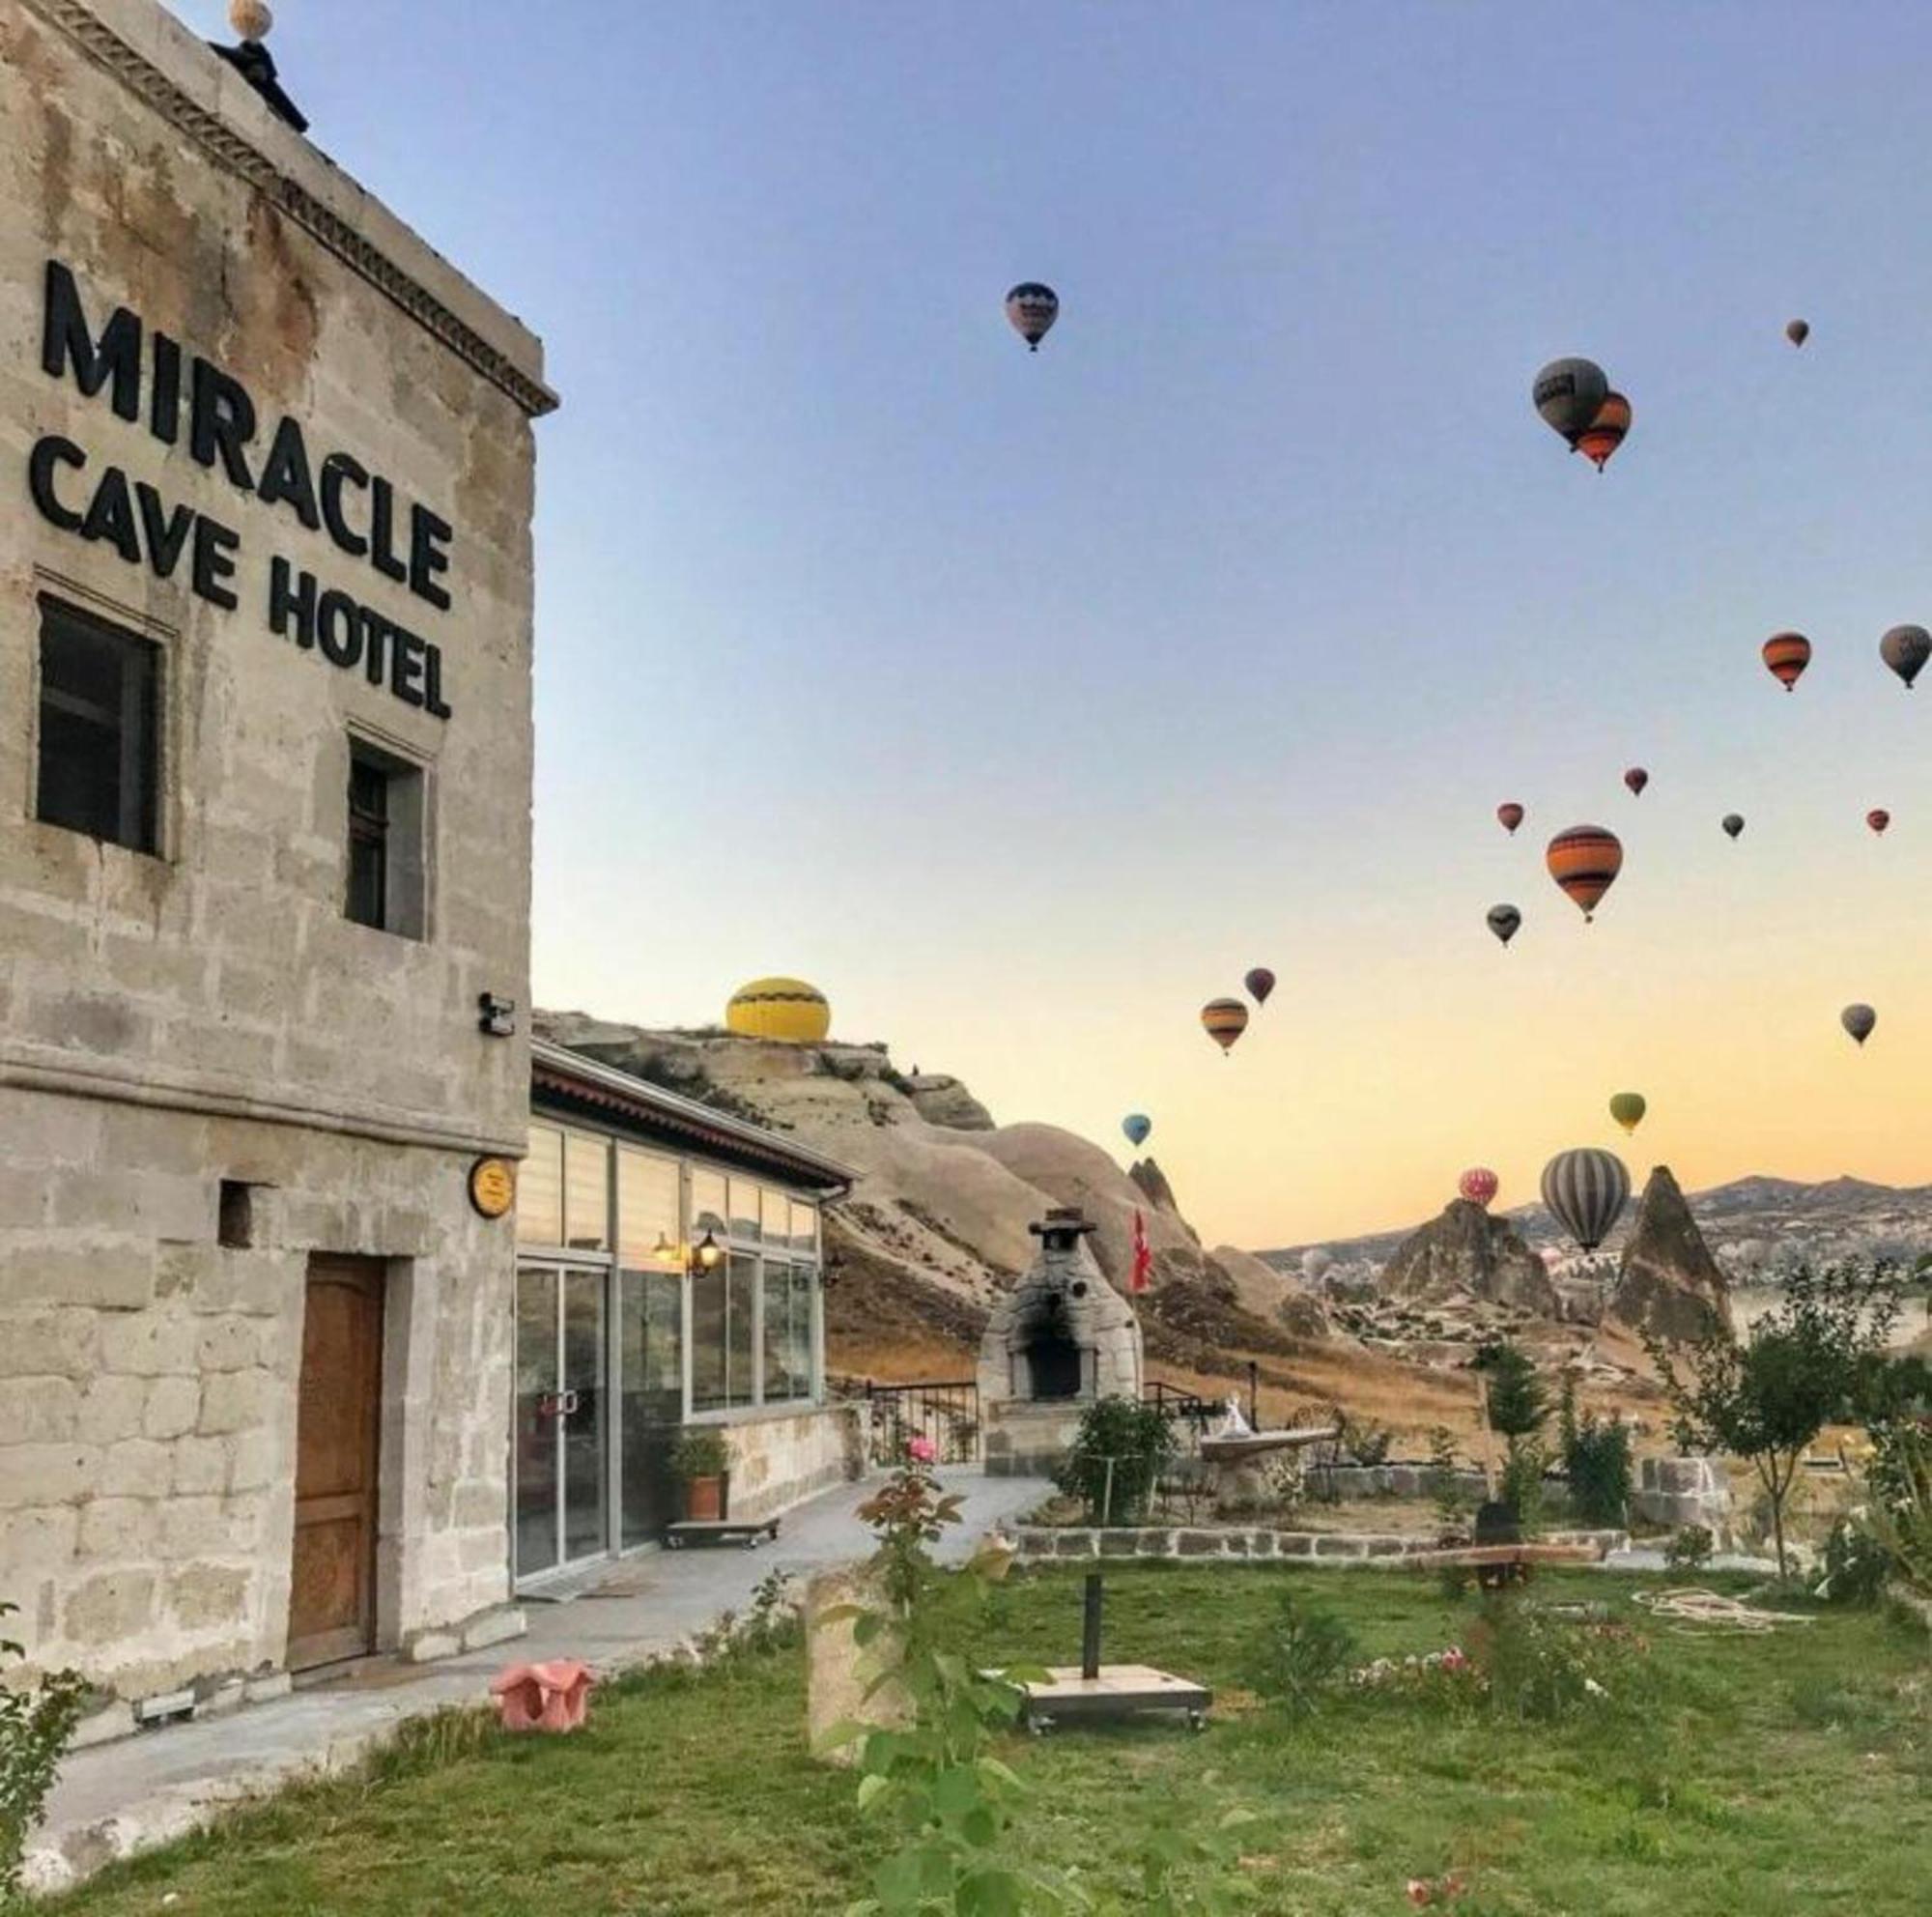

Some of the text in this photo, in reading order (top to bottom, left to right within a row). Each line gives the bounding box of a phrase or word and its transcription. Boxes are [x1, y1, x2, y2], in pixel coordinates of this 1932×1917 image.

[29, 435, 452, 720] CAVE HOTEL
[42, 259, 453, 611] MIRACLE
